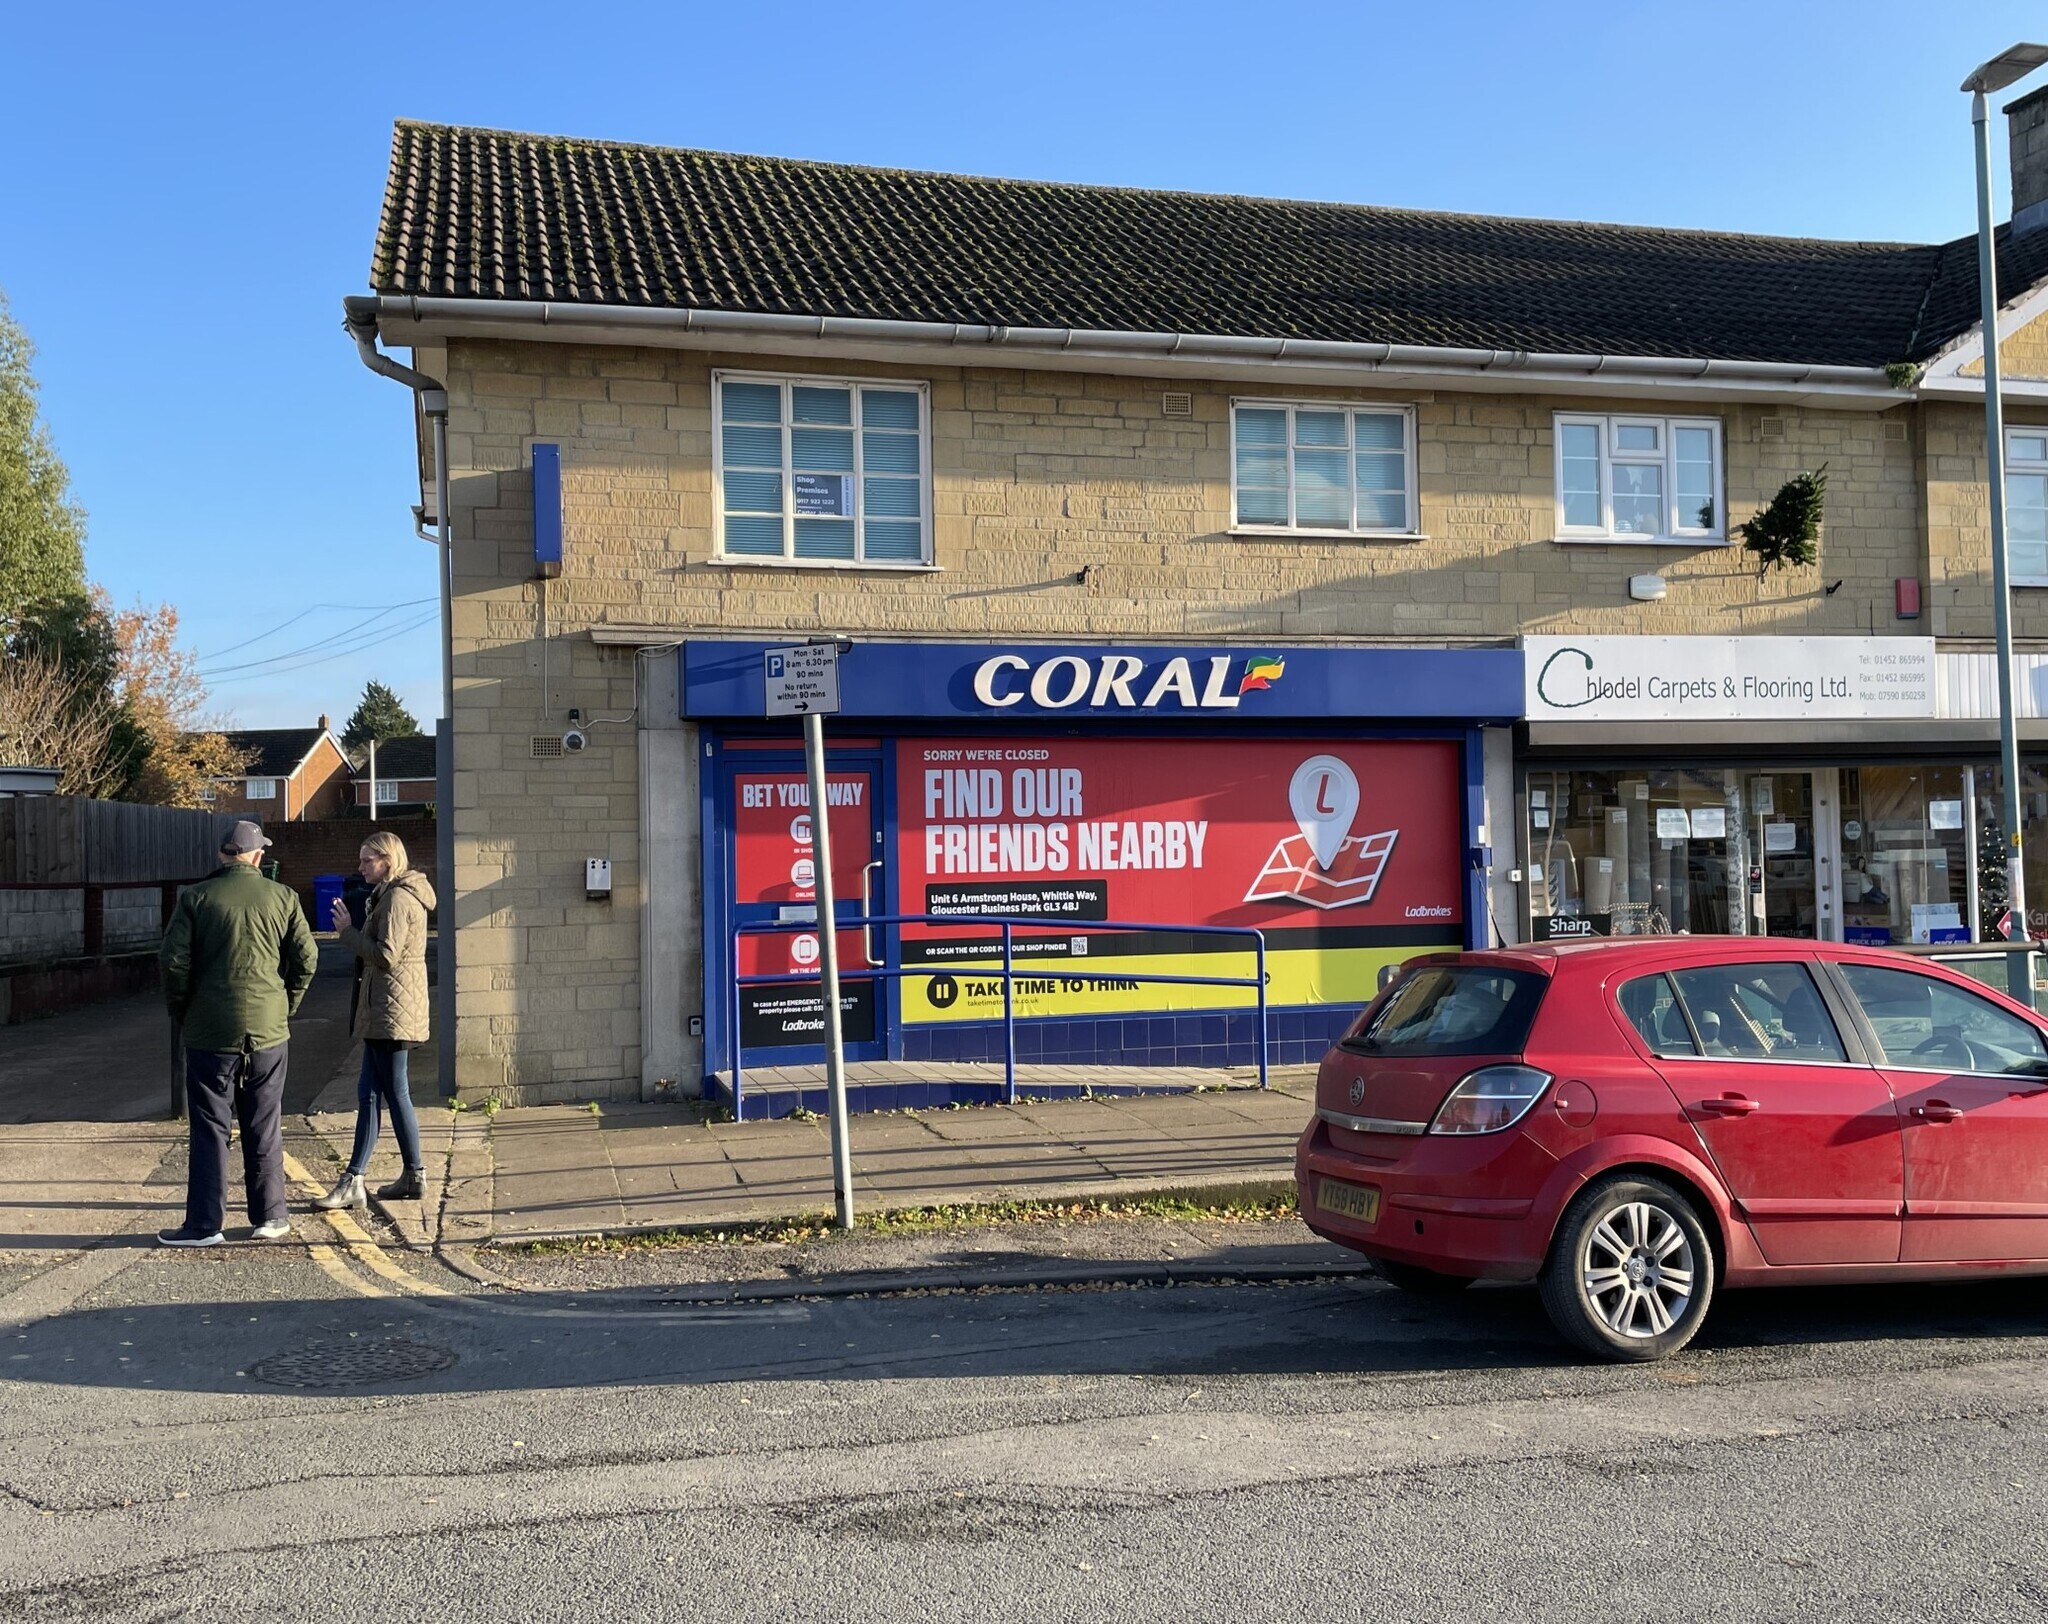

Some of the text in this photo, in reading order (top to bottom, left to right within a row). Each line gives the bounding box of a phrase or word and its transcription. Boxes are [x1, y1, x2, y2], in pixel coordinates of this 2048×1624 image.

[770, 657, 781, 676] P
[806, 658, 822, 666] 6.30
[1859, 655, 1925, 664] Tel: 01452 865994
[974, 655, 1240, 708] CORAL
[1538, 648, 1852, 708] Chlodel Carpets & Flooring Ltd.
[1859, 673, 1873, 682] Fax:
[1876, 673, 1897, 682] 01452
[1860, 692, 1876, 700] Mob:
[1878, 692, 1899, 700] 07590
[924, 749, 1049, 761] SORRY WE'RE CLOSED
[743, 783, 863, 807] BET YOU WAY
[925, 768, 1083, 818] FIND OUR
[925, 821, 1208, 874] FRIENDS NEARBY
[931, 890, 1097, 904] Unit 6 Armstrong House, Whittle Way,
[931, 901, 1079, 915] Gloucester Business Park GL3 4BJ
[1405, 906, 1452, 917] Ladbrokes
[1549, 918, 1591, 935] Sharp
[1014, 980, 1056, 994] TIME
[1060, 980, 1083, 992] TO
[782, 1019, 825, 1031] Ladbroke
